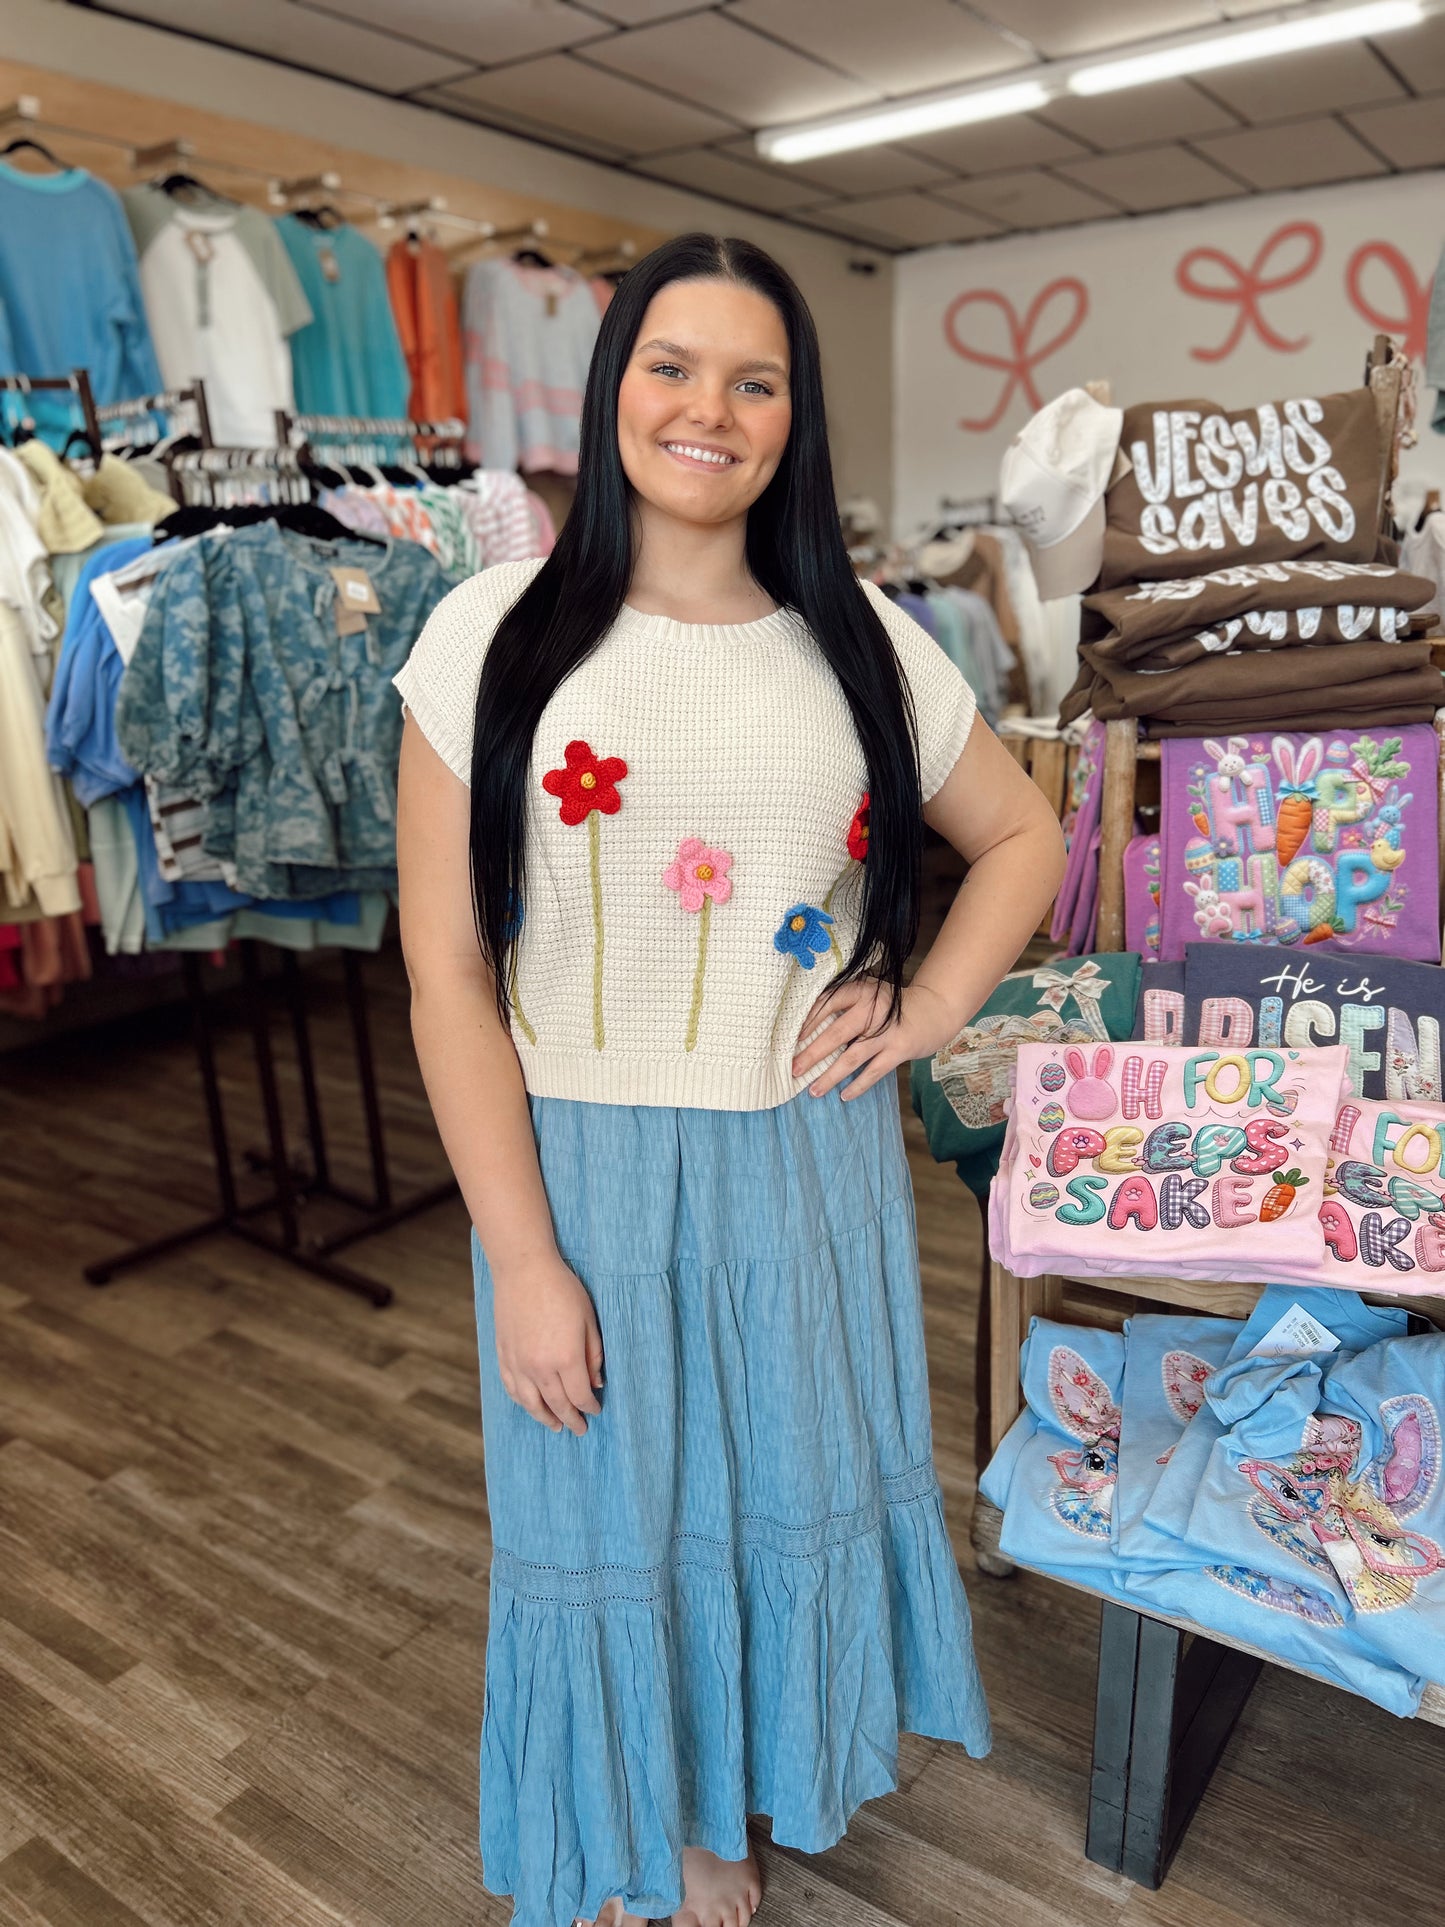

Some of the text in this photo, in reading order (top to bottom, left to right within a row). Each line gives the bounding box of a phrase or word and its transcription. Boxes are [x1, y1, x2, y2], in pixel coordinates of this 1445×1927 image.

[1211, 849, 1396, 935] HOP
[1260, 962, 1385, 1001] He is
[1183, 1050, 1285, 1109] FOR
[1046, 1119, 1290, 1178] PEEPS
[1372, 1112, 1445, 1179] FO
[1055, 1175, 1258, 1231] SAKE
